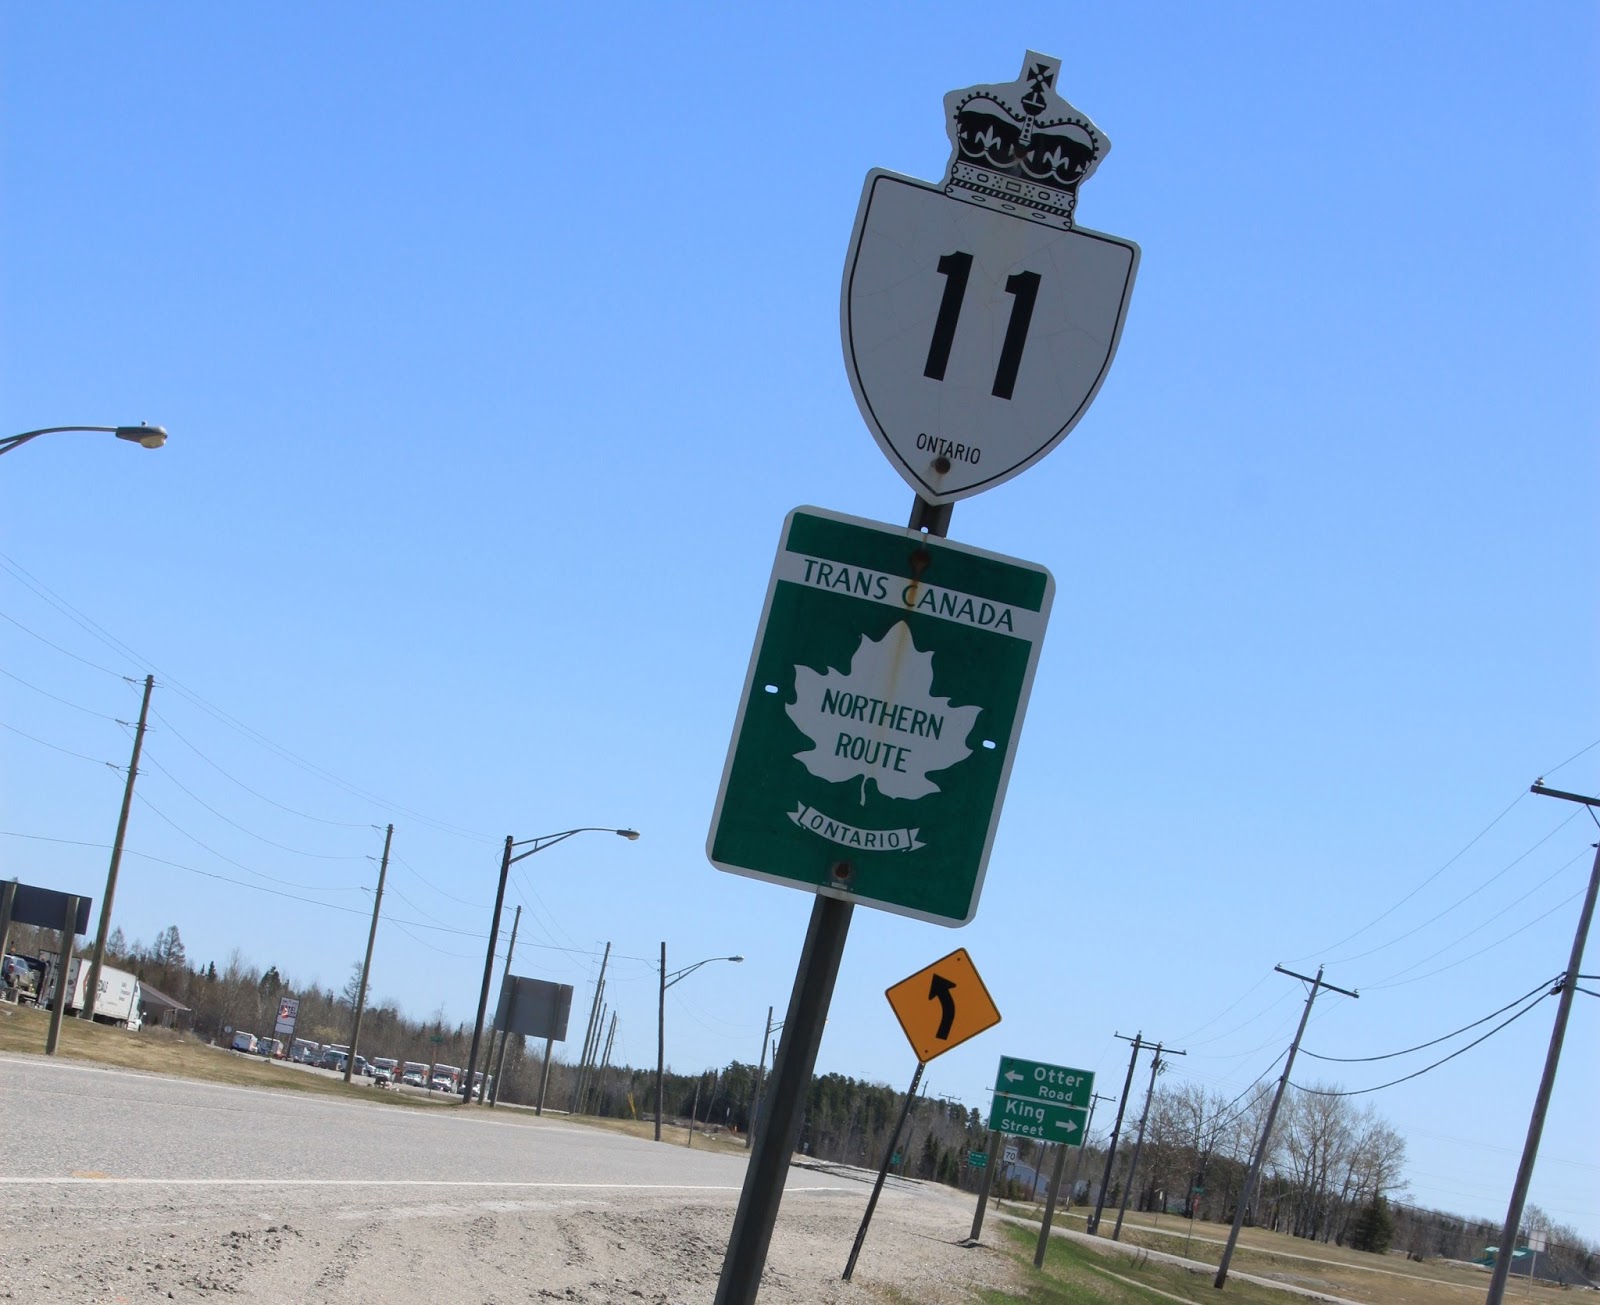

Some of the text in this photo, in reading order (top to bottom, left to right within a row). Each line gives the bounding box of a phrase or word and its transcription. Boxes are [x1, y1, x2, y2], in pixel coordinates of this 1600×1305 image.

[924, 251, 1041, 400] 11
[916, 433, 981, 464] ONTARIO
[803, 559, 1014, 632] TRANS CANADA
[820, 688, 943, 740] NORTHERN
[834, 733, 911, 773] ROUTE
[810, 815, 900, 848] ONTARIO
[1034, 1067, 1084, 1087] Otter
[1039, 1086, 1073, 1101] Road
[1005, 1100, 1045, 1123] King
[1001, 1119, 1044, 1136] Street
[1005, 1151, 1016, 1161] 70
